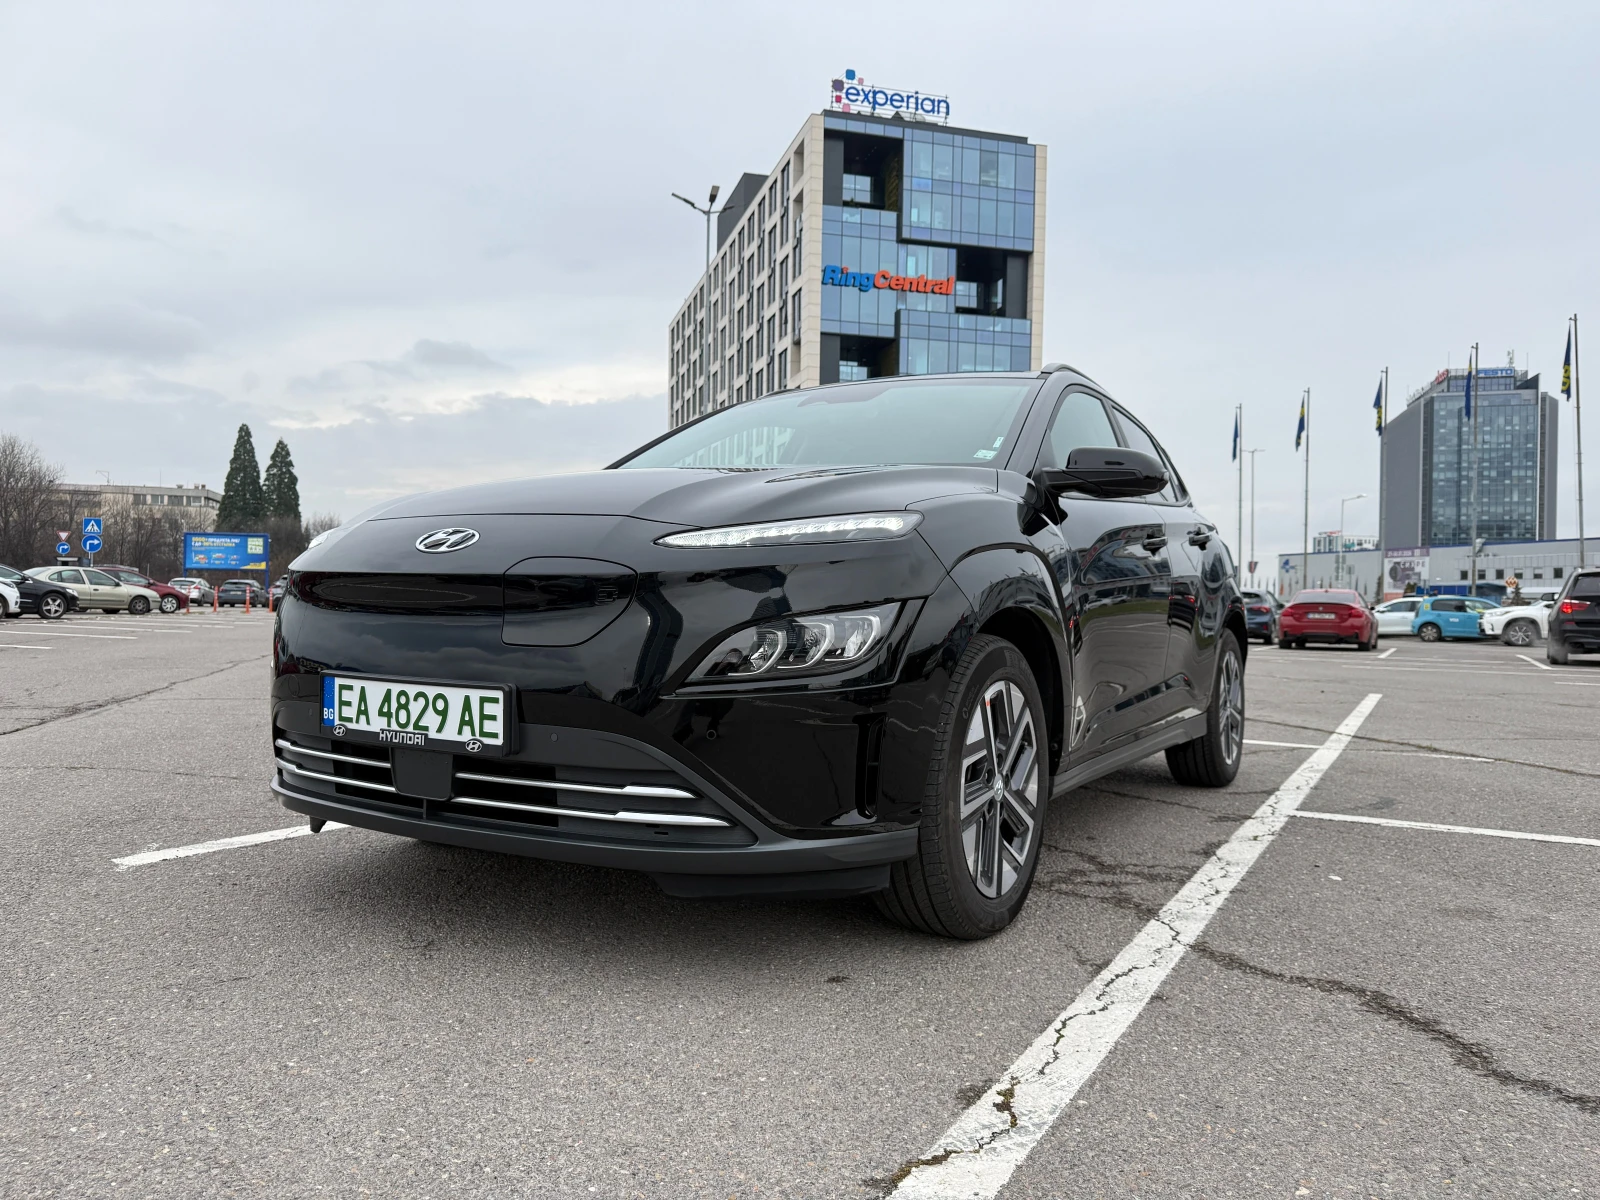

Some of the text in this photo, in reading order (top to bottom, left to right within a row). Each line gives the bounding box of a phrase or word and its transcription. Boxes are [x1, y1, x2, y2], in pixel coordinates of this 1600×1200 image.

[845, 84, 950, 116] experian
[822, 265, 955, 295] RingCentral
[1477, 368, 1513, 377] FESTO
[323, 707, 334, 720] BG
[338, 683, 500, 739] EA 4829 AE
[379, 729, 425, 746] HYUNDAI
